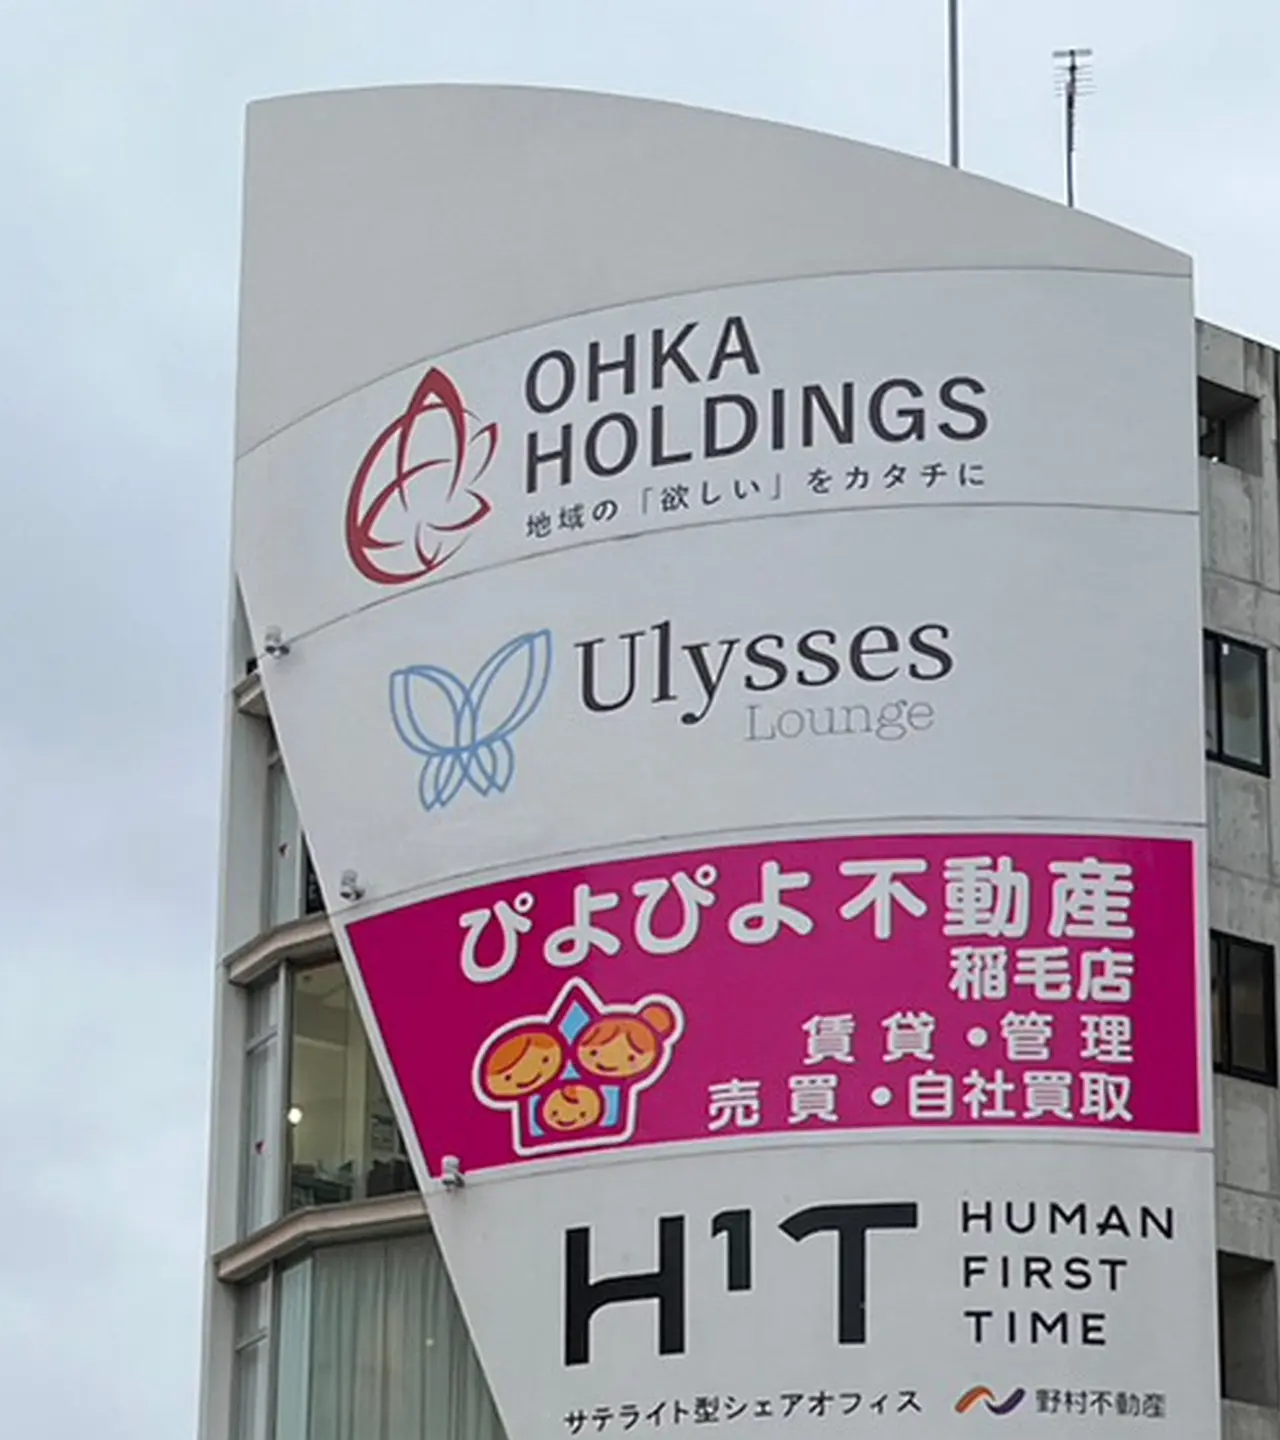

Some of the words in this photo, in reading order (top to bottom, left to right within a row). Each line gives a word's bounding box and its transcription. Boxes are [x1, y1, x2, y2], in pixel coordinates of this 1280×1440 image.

[525, 316, 760, 414] OHKA
[526, 376, 988, 494] HOLDINGS
[525, 462, 986, 539] 地域の「欲しい」をカタチに
[574, 620, 954, 726] Ulysses
[745, 699, 936, 742] Lounge
[459, 856, 1135, 983] ぴよぴよ不動産
[949, 946, 1135, 1002] 稲毛店
[802, 1013, 1135, 1067] 賃貸・管理
[707, 1070, 1135, 1133] 売買・自社買取
[961, 1200, 1174, 1239] HUMAN
[962, 1256, 1128, 1292] FIRST
[964, 1310, 1107, 1346] TIME
[565, 1389, 922, 1434] サテライト型シェアオフィス
[1035, 1388, 1168, 1418] 野村不動産
